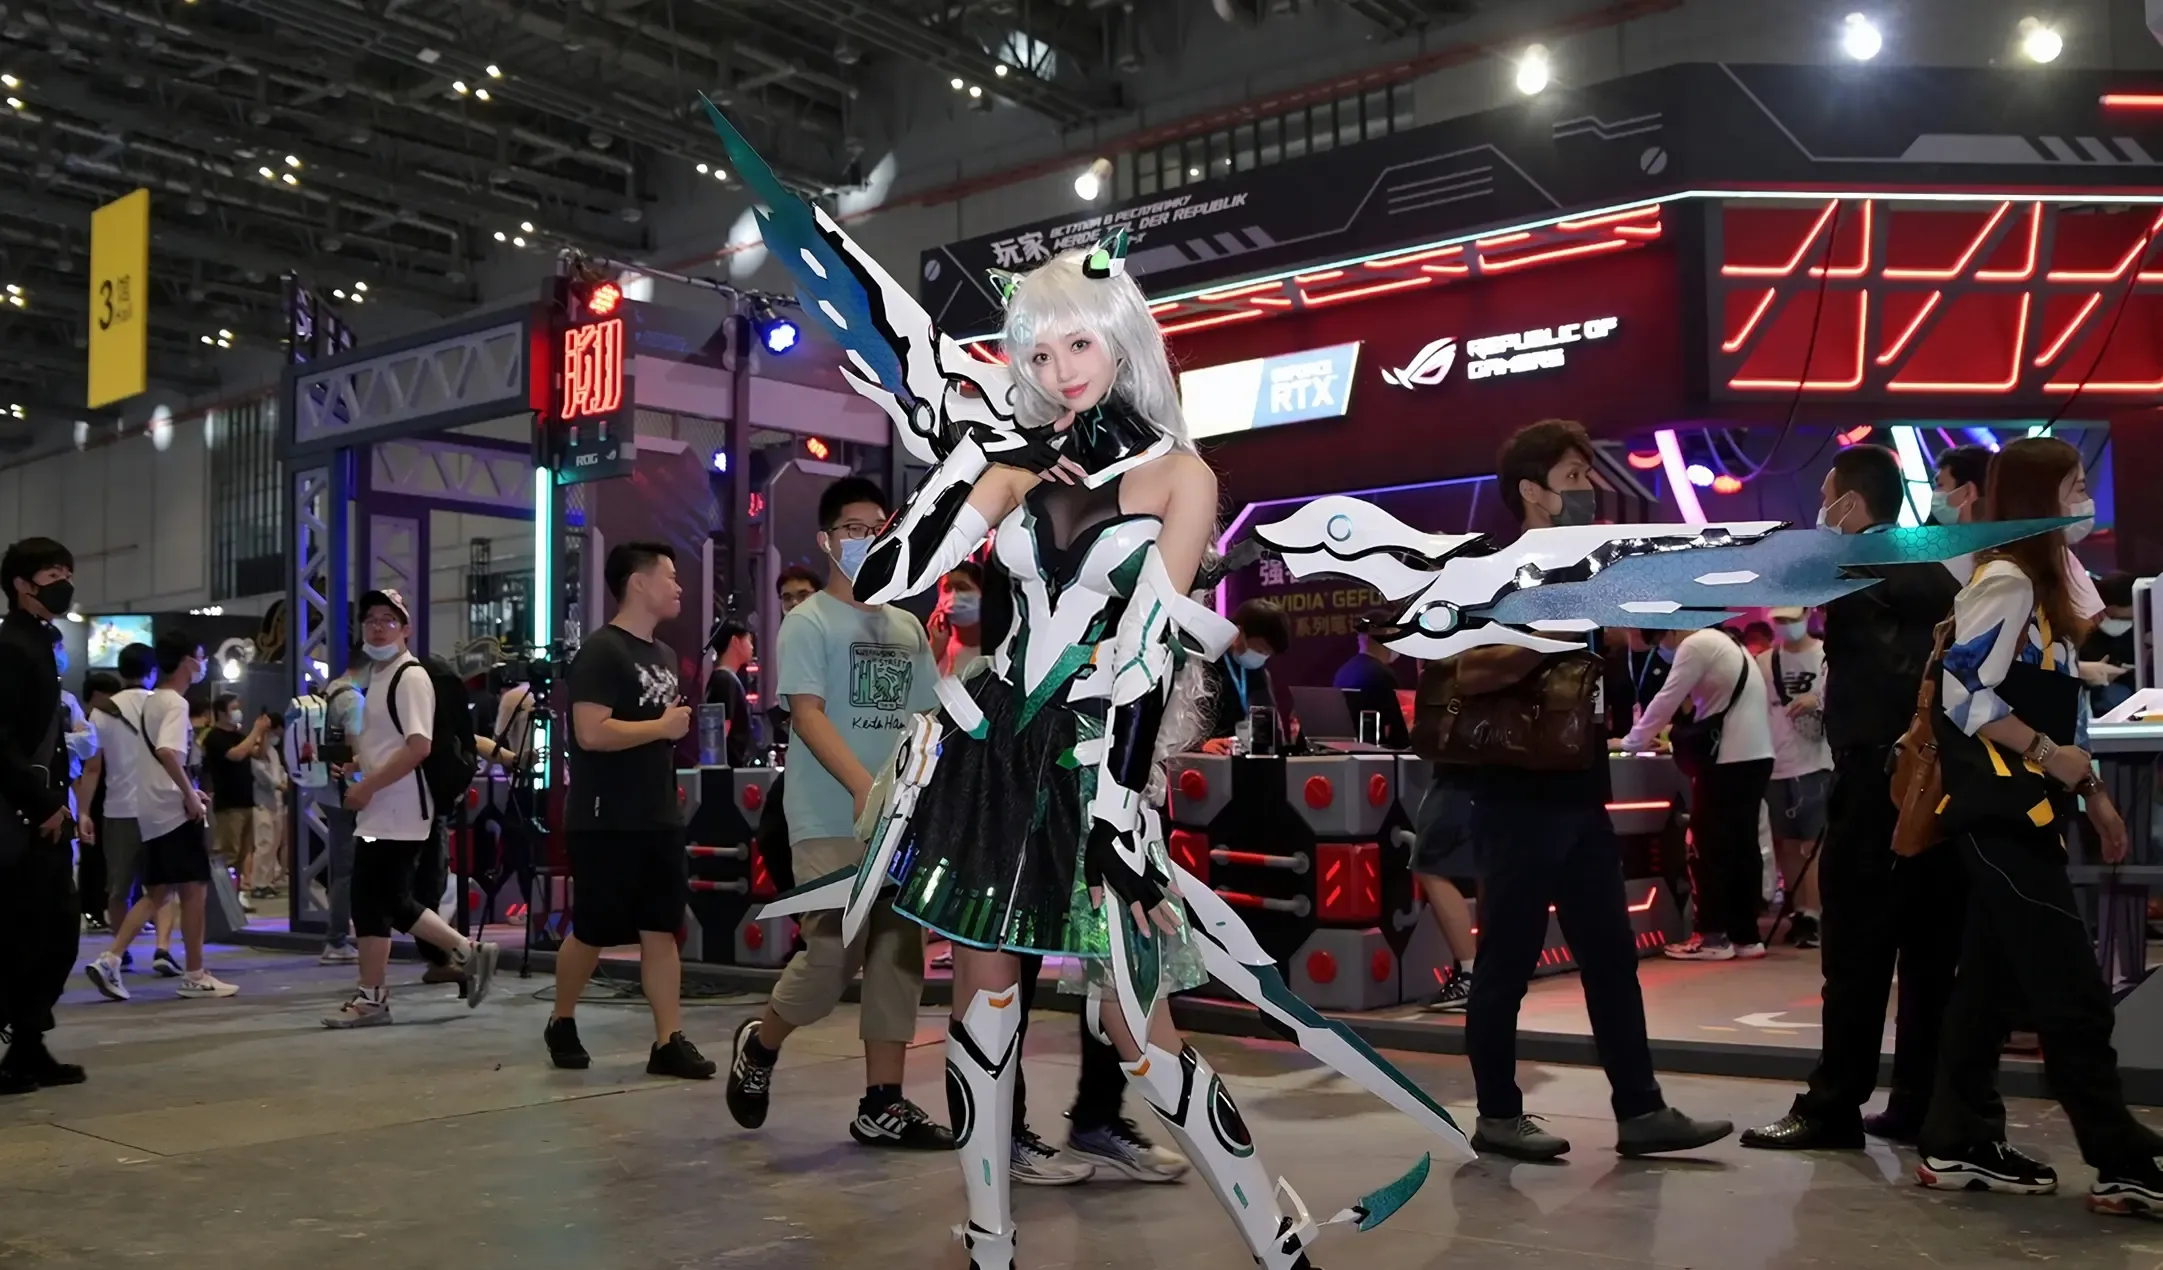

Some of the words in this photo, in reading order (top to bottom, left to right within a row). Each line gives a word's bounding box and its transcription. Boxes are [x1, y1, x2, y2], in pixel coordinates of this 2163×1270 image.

[1139, 212, 1170, 230] DER
[1173, 192, 1248, 222] REPUBLIK
[991, 231, 1050, 268] 玩家
[99, 280, 112, 331] 3
[1467, 322, 1582, 360] REPUBLIC
[1584, 316, 1618, 339] OF
[1270, 374, 1339, 414] RTX
[576, 453, 598, 467] ROG
[1333, 589, 1388, 608] GEFO
